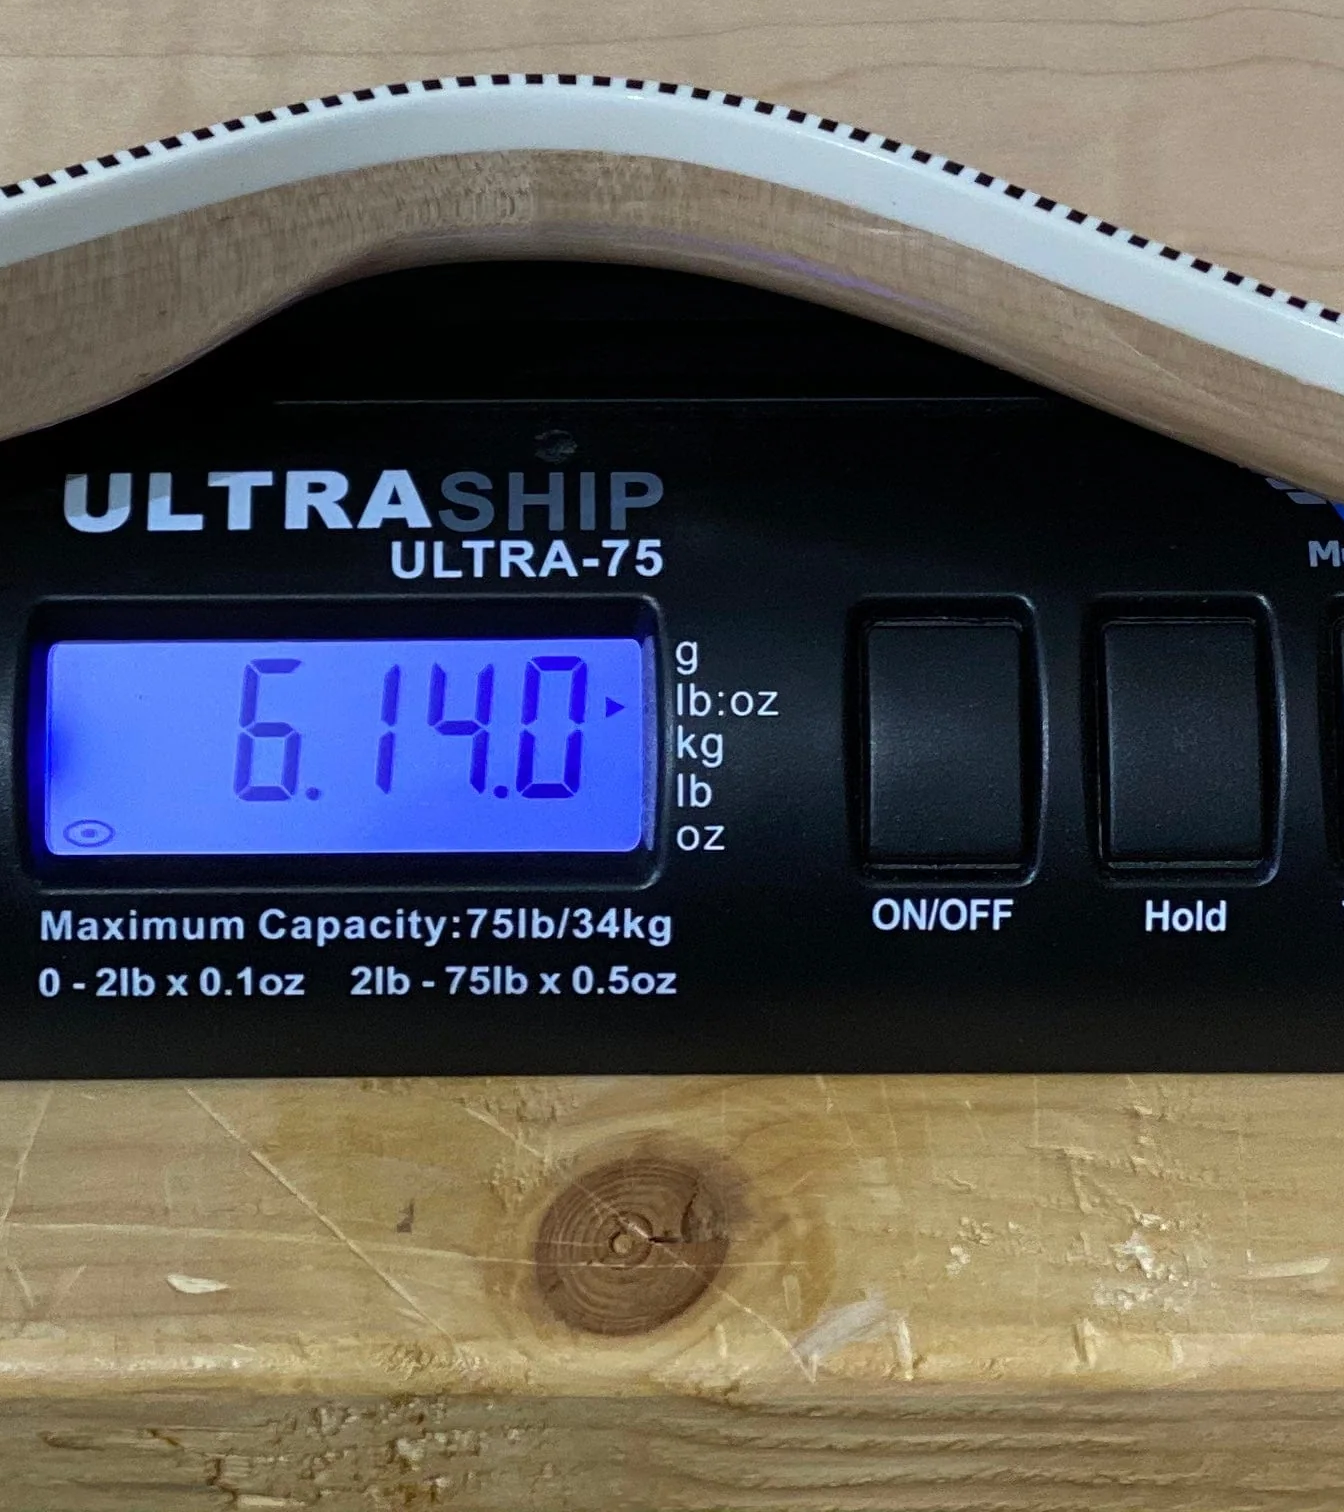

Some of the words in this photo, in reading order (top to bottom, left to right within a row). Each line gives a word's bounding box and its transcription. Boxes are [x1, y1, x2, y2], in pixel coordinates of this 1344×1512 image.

[62, 468, 665, 533] ULTRASHIP
[390, 538, 665, 580] ULTRA-75
[674, 639, 700, 674] g
[674, 681, 781, 717] lb:oz
[232, 655, 589, 803] 6.14.0
[674, 729, 725, 768] kg
[674, 779, 713, 809] lb
[674, 823, 727, 852] oz
[39, 909, 245, 943] Maximum
[870, 897, 1014, 932] ON/OFF
[1143, 899, 1227, 933] Hold
[37, 967, 60, 998] 0
[94, 966, 156, 997] 2lb
[165, 974, 189, 997] x
[198, 966, 306, 997] 0.1oz
[349, 965, 411, 996] 2lb
[444, 964, 529, 995] 75lb
[538, 973, 561, 995] x
[570, 964, 678, 996] 0.5oz
